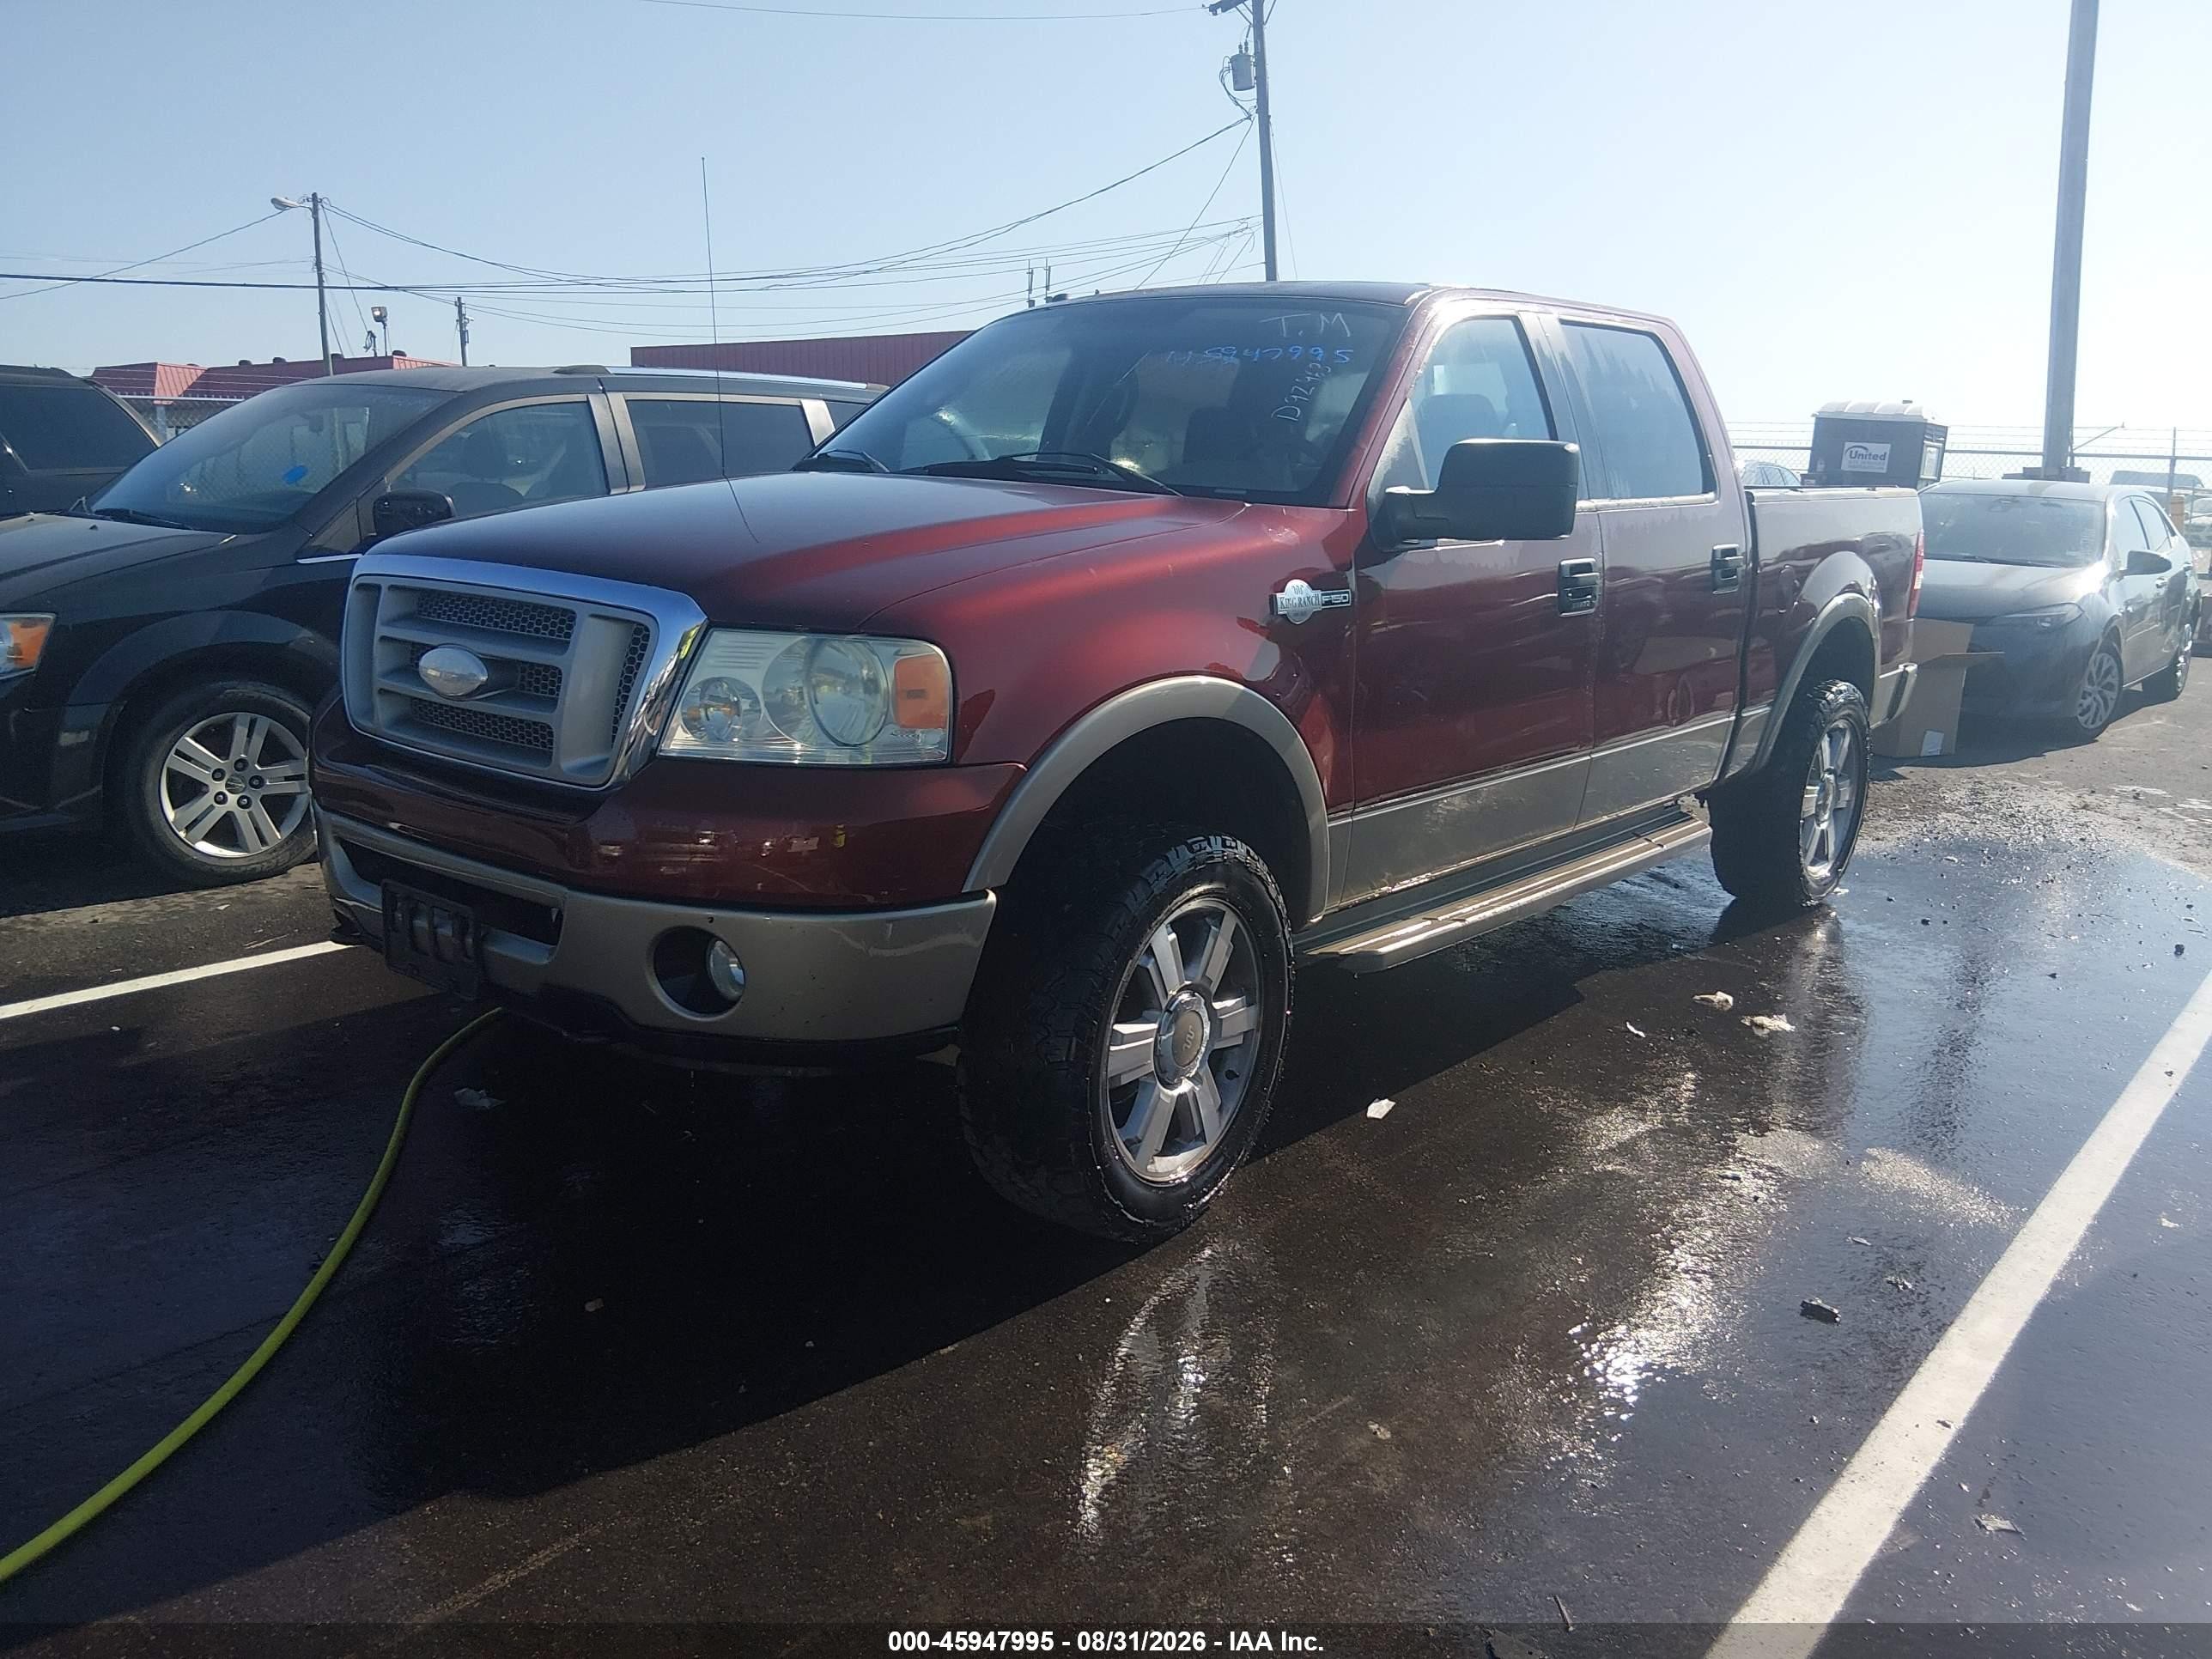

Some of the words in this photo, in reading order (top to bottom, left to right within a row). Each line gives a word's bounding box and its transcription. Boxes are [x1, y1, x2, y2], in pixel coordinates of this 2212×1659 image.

[1849, 450, 1887, 461] United
[1279, 596, 1297, 610] KING
[1297, 592, 1321, 608] RANCH
